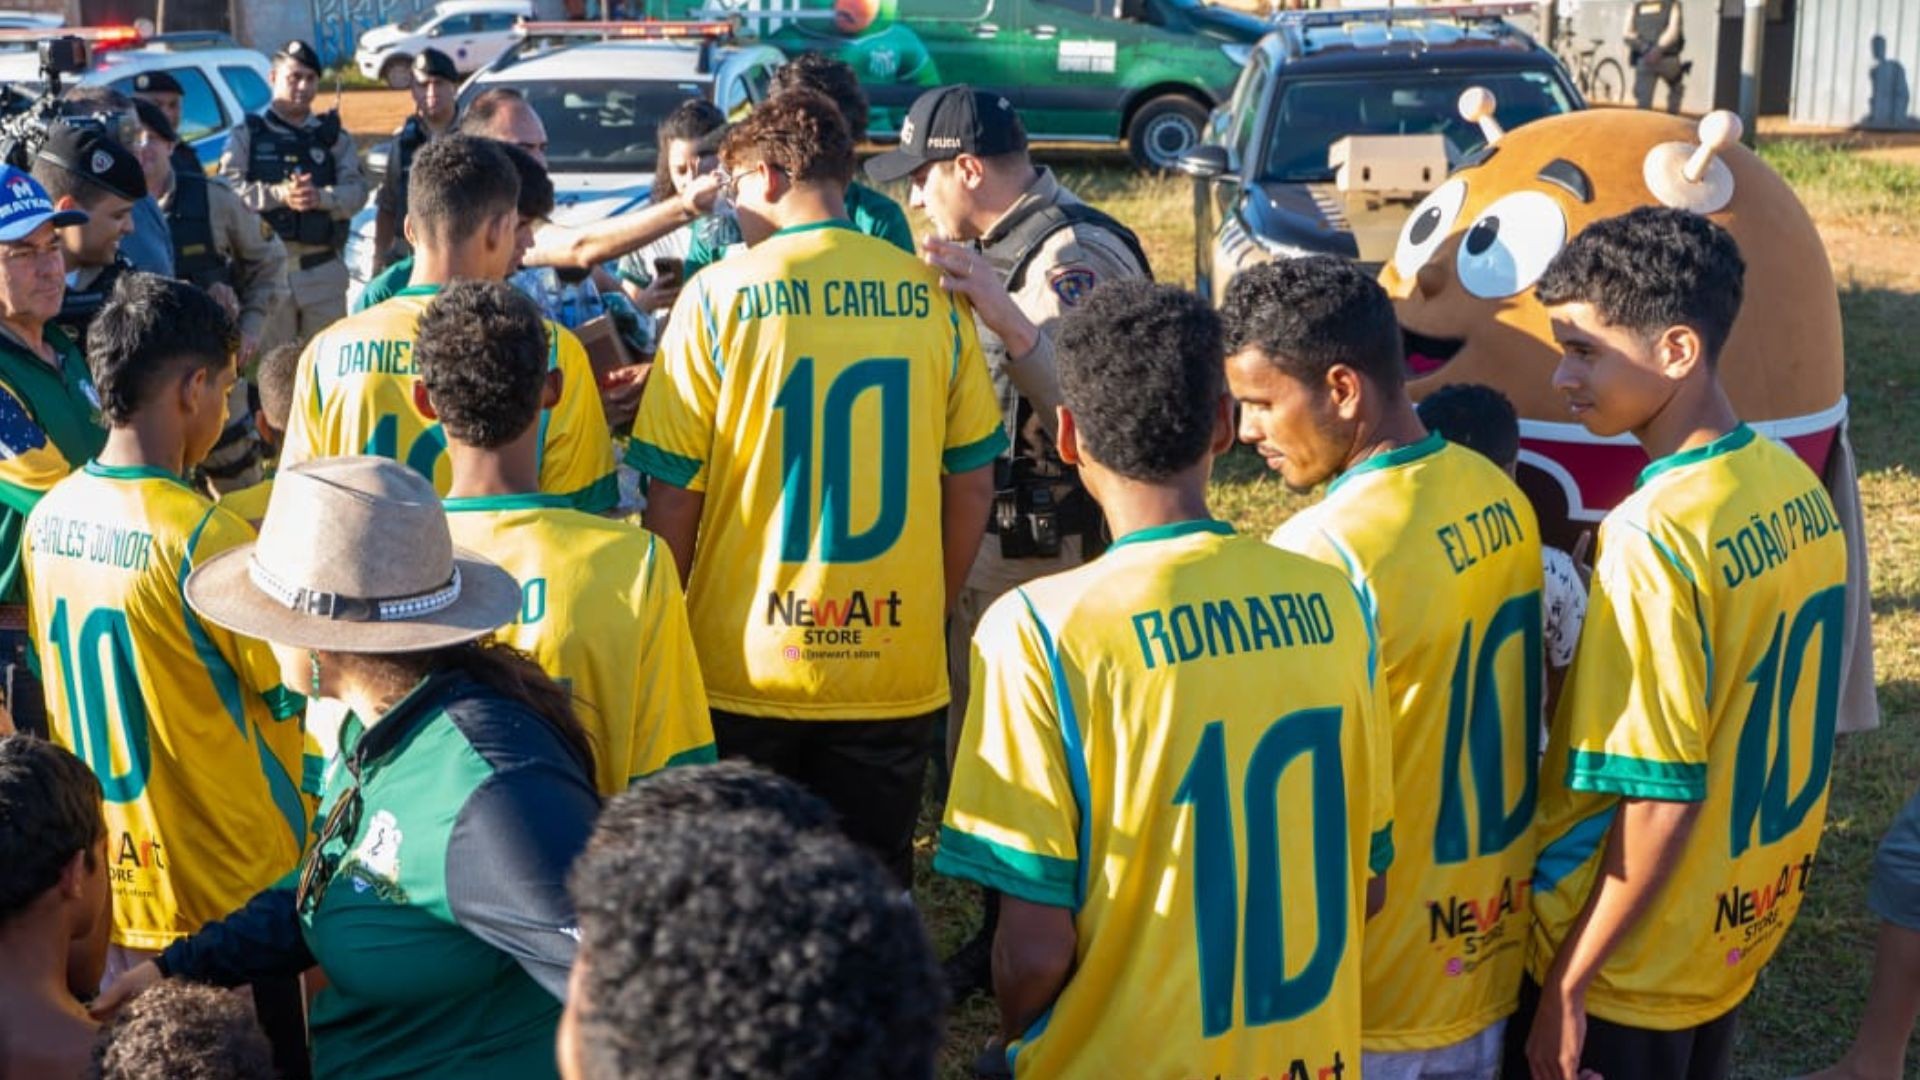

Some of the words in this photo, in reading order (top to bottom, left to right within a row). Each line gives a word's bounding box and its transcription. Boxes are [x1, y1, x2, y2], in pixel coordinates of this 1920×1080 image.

[737, 279, 811, 321] JUAN
[824, 280, 929, 318] CARLOS
[772, 357, 910, 563] 10
[1437, 498, 1524, 574] ELTON
[1716, 512, 1788, 588] JOÃO
[48, 598, 151, 803] 10
[804, 630, 861, 645] STORE
[1131, 592, 1334, 669] ROMARIO
[1434, 588, 1542, 865] 10
[1730, 584, 1846, 859] 10
[1172, 706, 1347, 1037] 10
